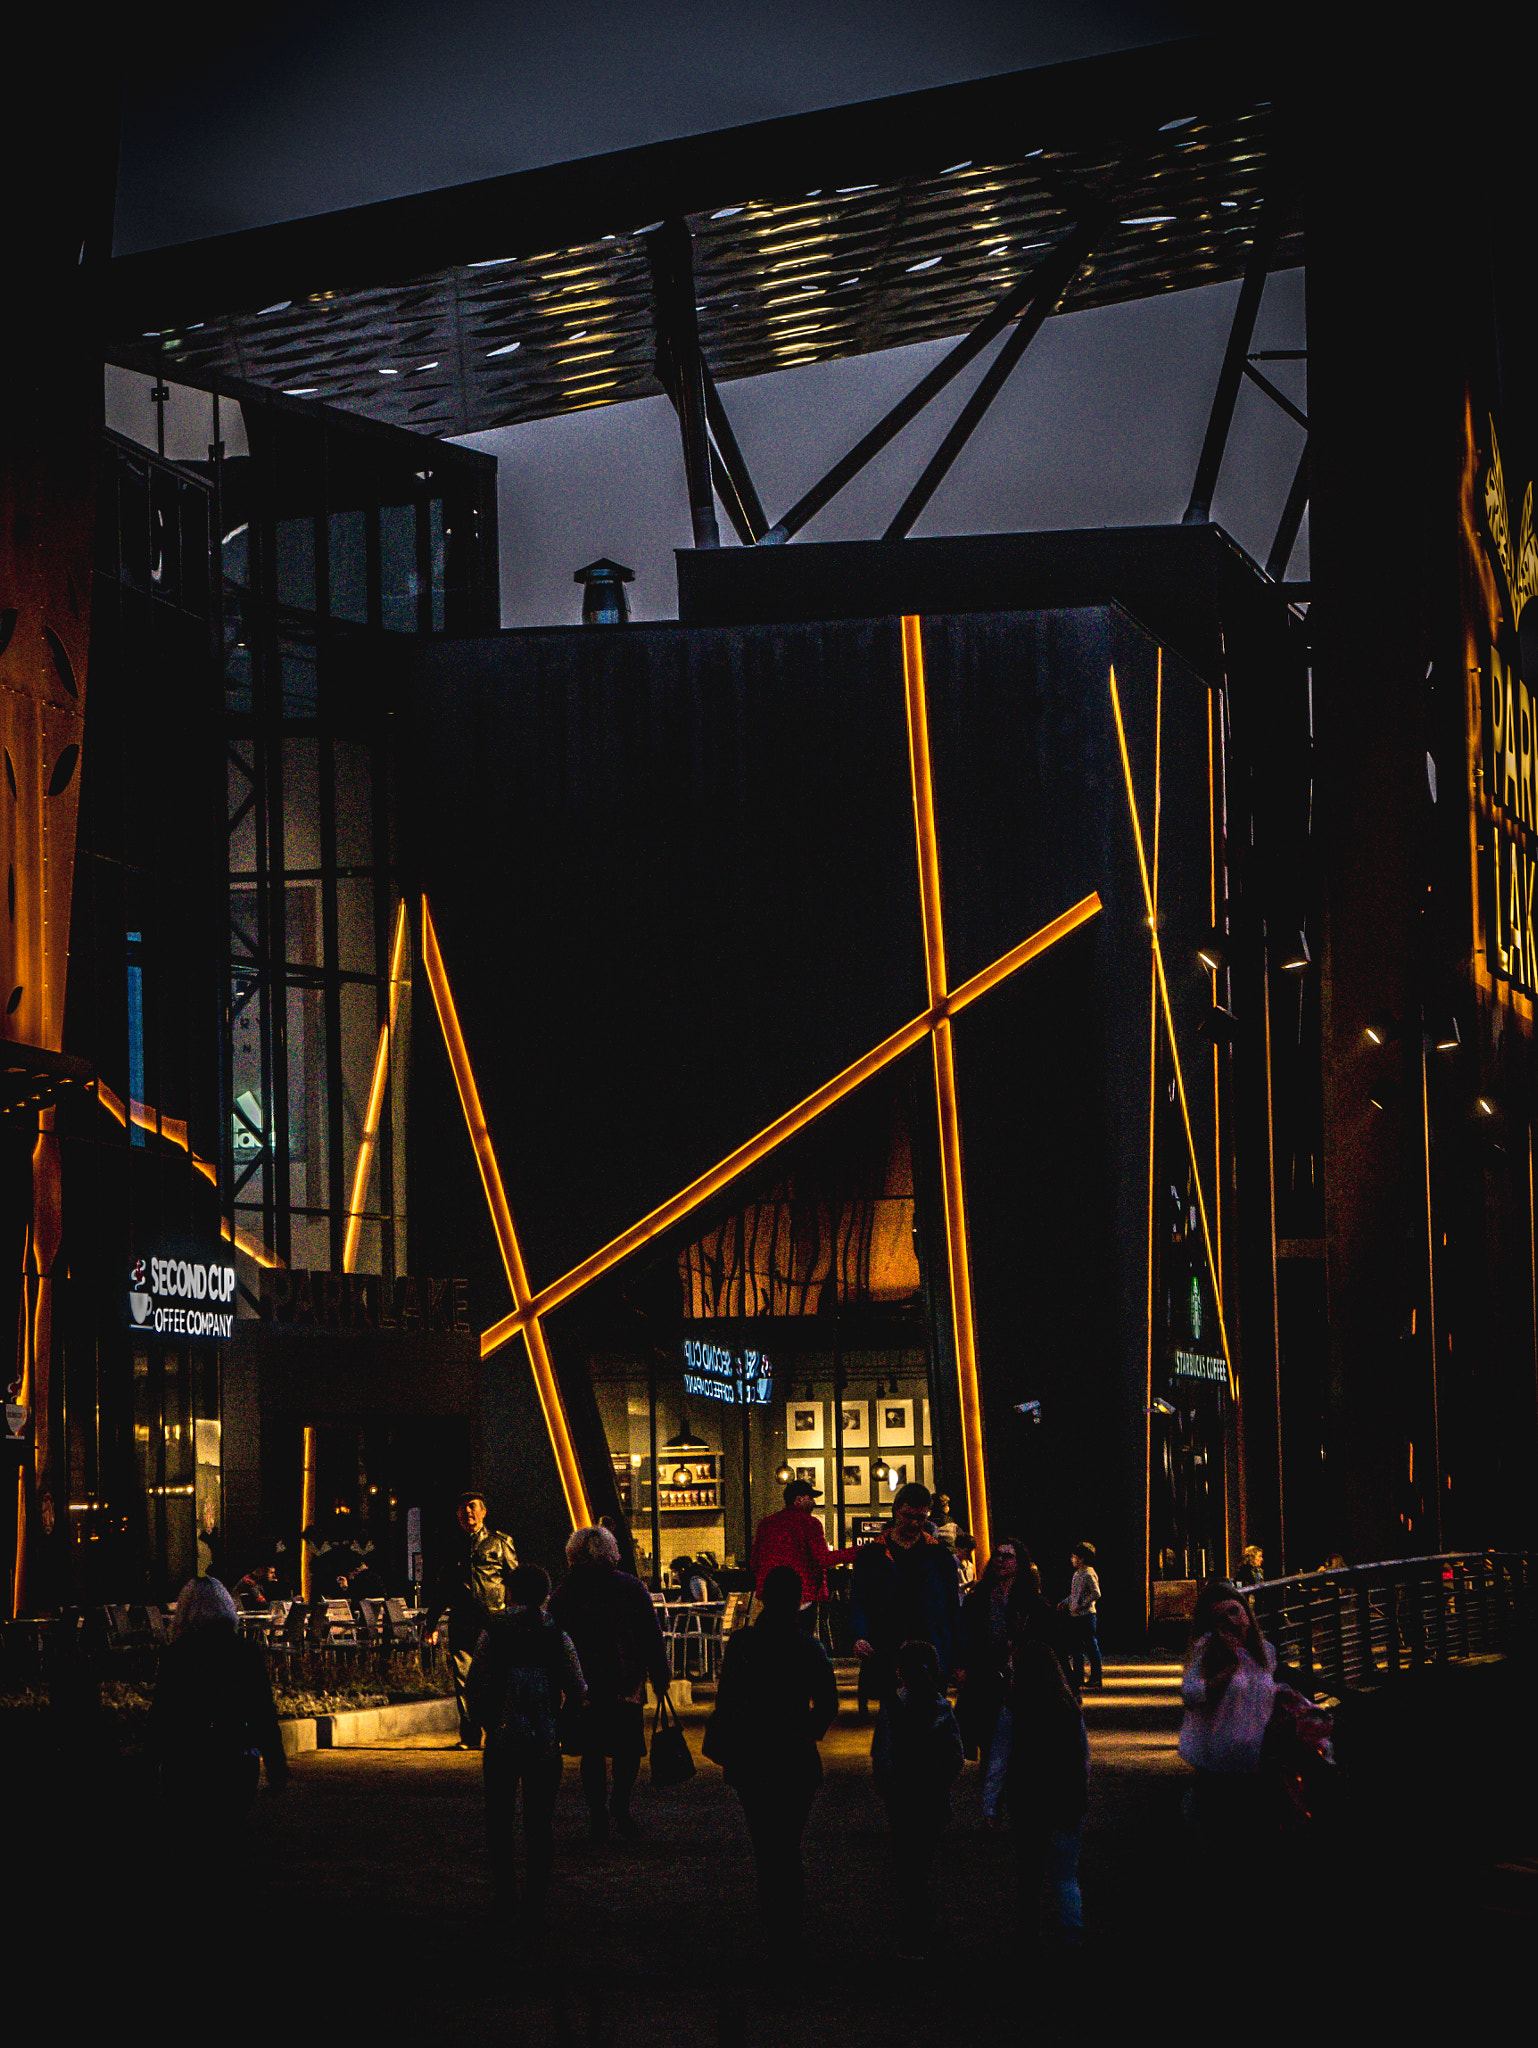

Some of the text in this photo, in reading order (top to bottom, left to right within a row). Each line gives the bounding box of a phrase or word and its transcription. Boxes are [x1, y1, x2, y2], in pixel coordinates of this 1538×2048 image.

[1490, 644, 1538, 835] PAR
[151, 1257, 235, 1302] SECOND CUP
[153, 1308, 233, 1338] OFFEE COMPANY
[377, 1276, 471, 1334] LAKE
[1176, 1351, 1227, 1382] STARBUCKS COFFEE
